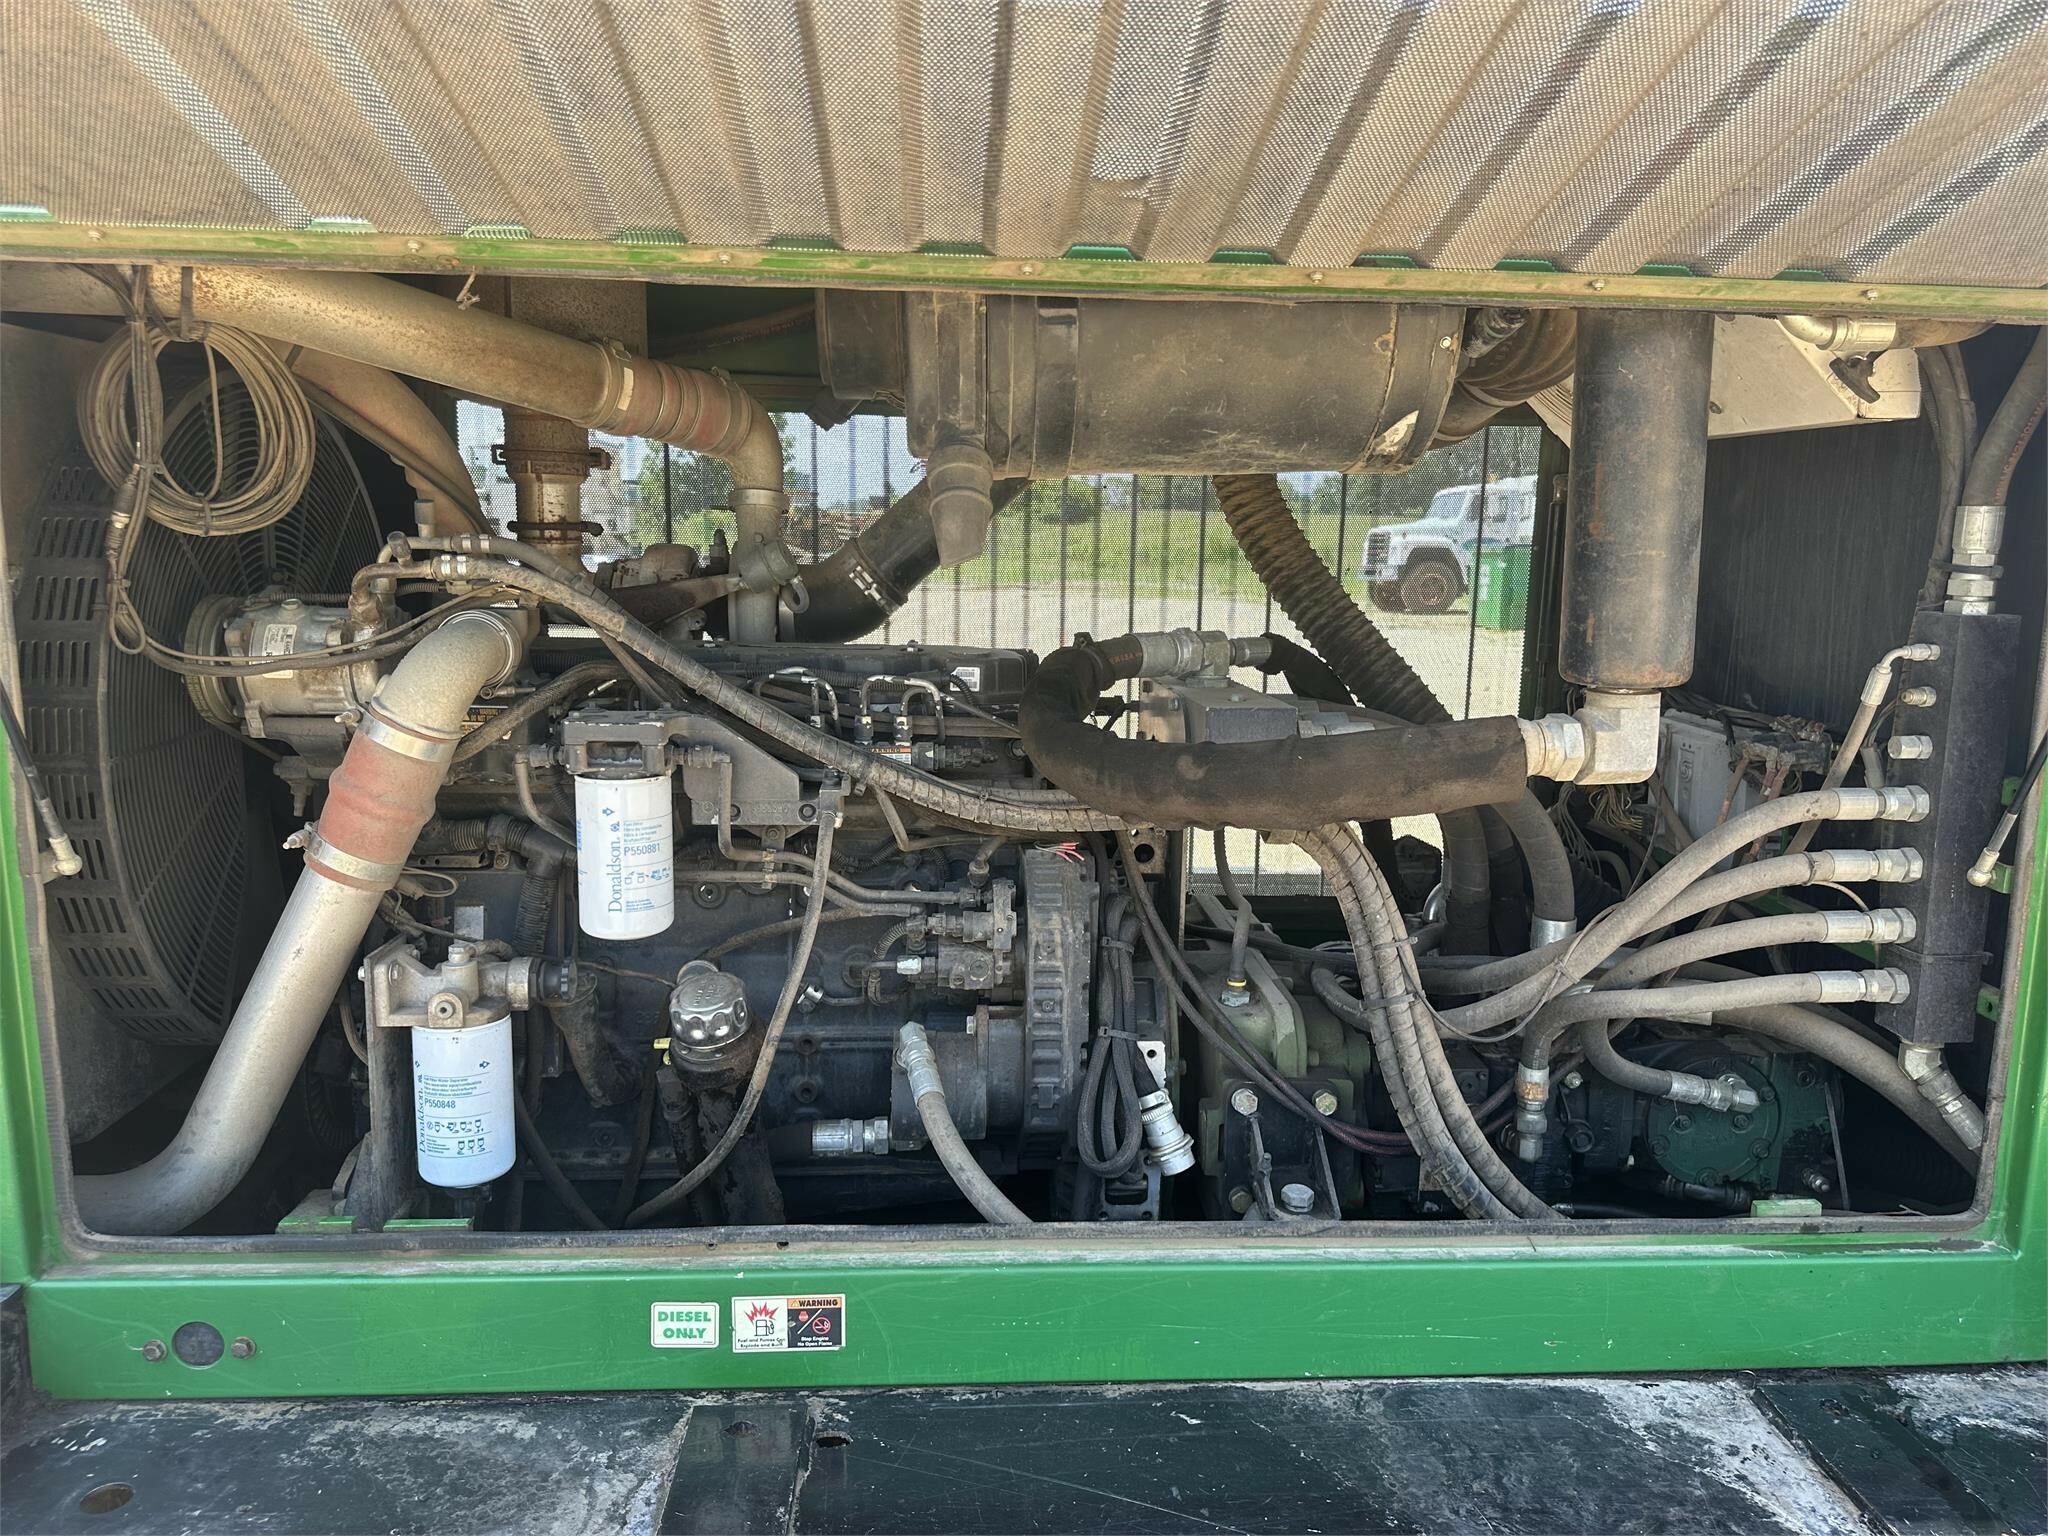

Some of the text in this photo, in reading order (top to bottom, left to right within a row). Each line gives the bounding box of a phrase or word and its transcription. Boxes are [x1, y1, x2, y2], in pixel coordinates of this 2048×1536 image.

[624, 843, 660, 856] P550881
[424, 1098, 456, 1109] P550848
[799, 1299, 838, 1307] WARNING
[657, 1311, 711, 1322] DIESEL
[663, 1327, 707, 1339] ONLY
